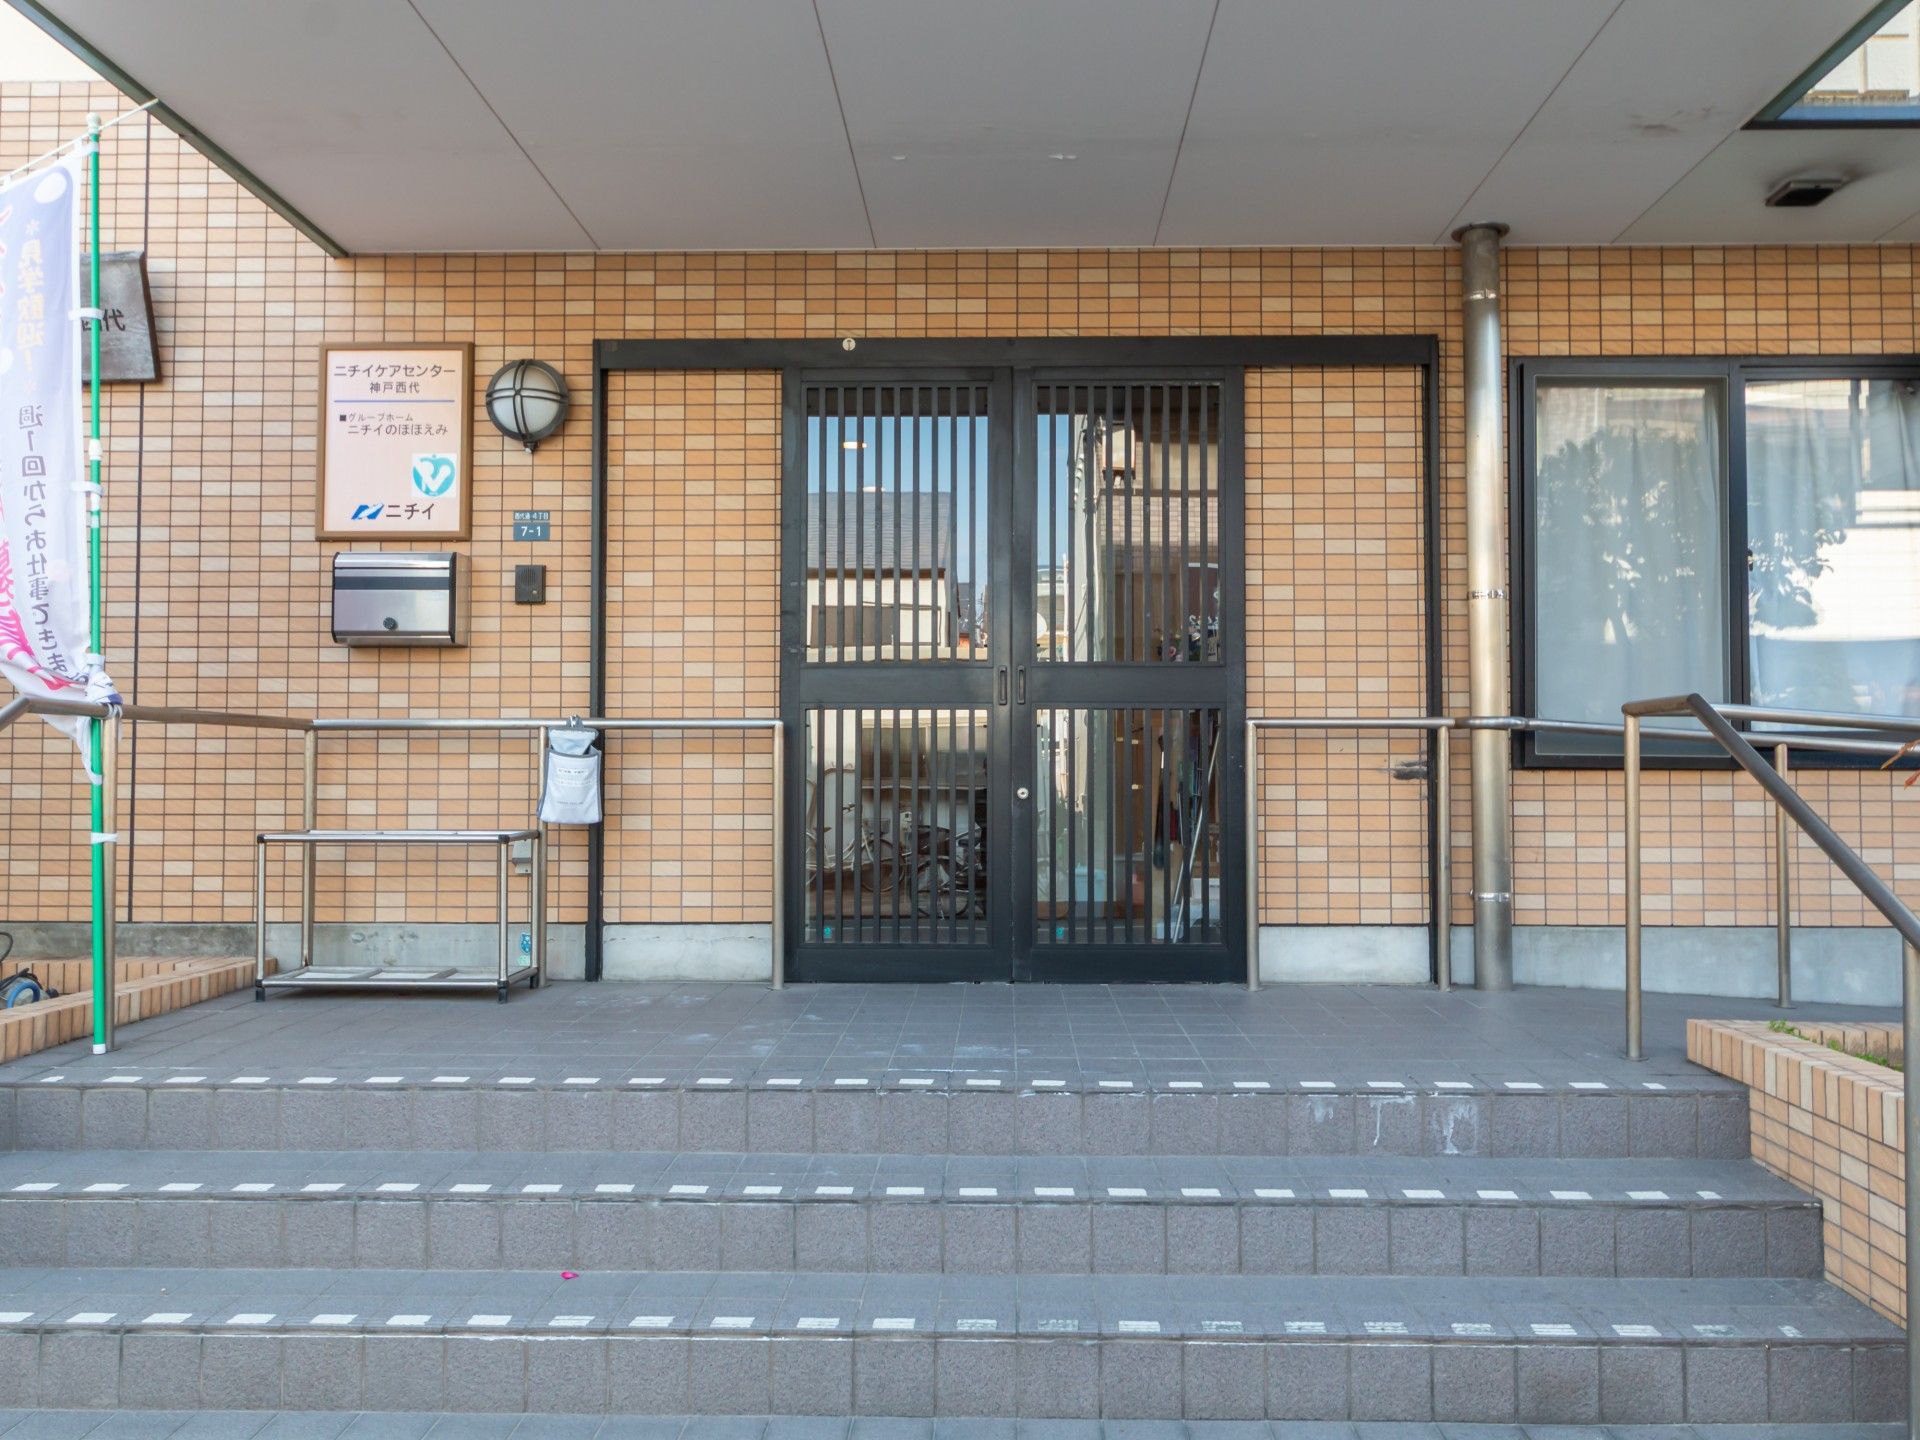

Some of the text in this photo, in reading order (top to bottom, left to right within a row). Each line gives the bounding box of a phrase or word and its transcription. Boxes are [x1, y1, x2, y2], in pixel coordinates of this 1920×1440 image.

[334, 364, 456, 378] ニチイケアセンター
[369, 381, 420, 394] 神戸西代
[348, 413, 414, 422] グループホーム
[348, 424, 448, 436] ニチイのほほえみ
[386, 503, 434, 520] ニチイ
[521, 525, 541, 537] 7-1
